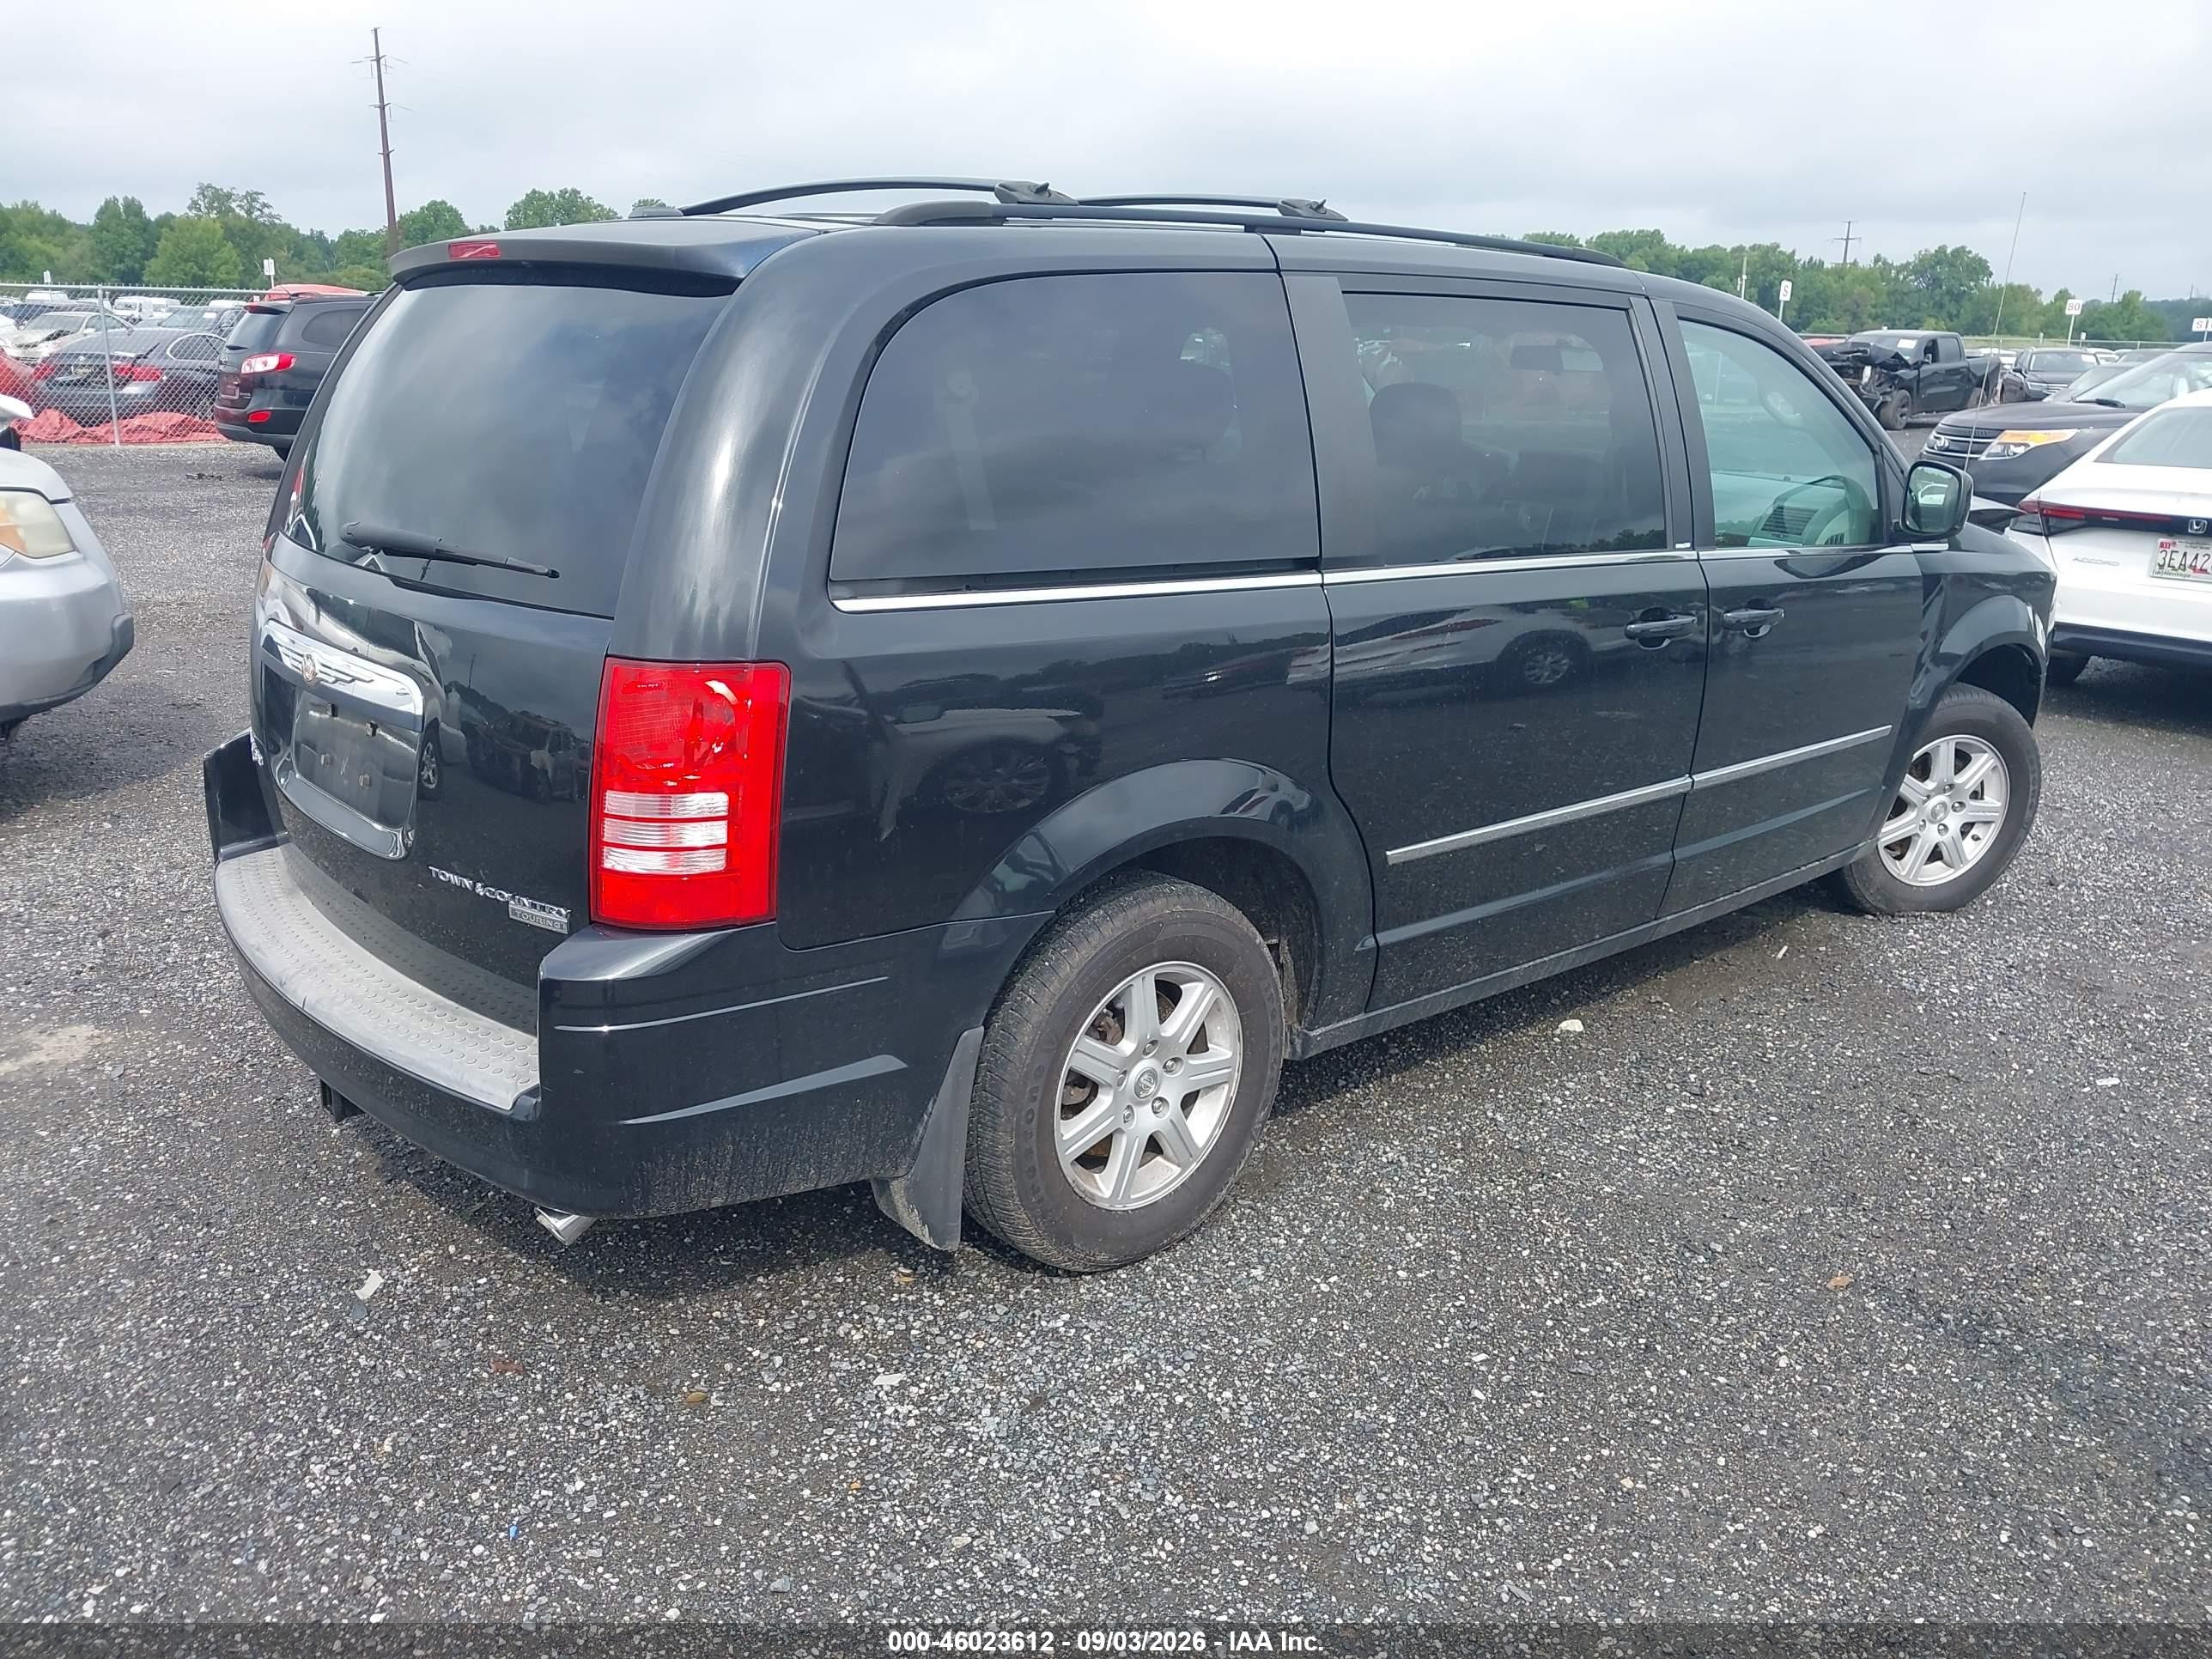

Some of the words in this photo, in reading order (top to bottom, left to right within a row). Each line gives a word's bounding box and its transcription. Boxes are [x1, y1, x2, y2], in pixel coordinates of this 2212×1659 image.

[2072, 556, 2120, 567] ACCORD
[2157, 549, 2212, 573] 3EA42
[428, 866, 473, 891] TOWN
[483, 886, 572, 920] COUNTRY
[516, 910, 562, 930] TOURING
